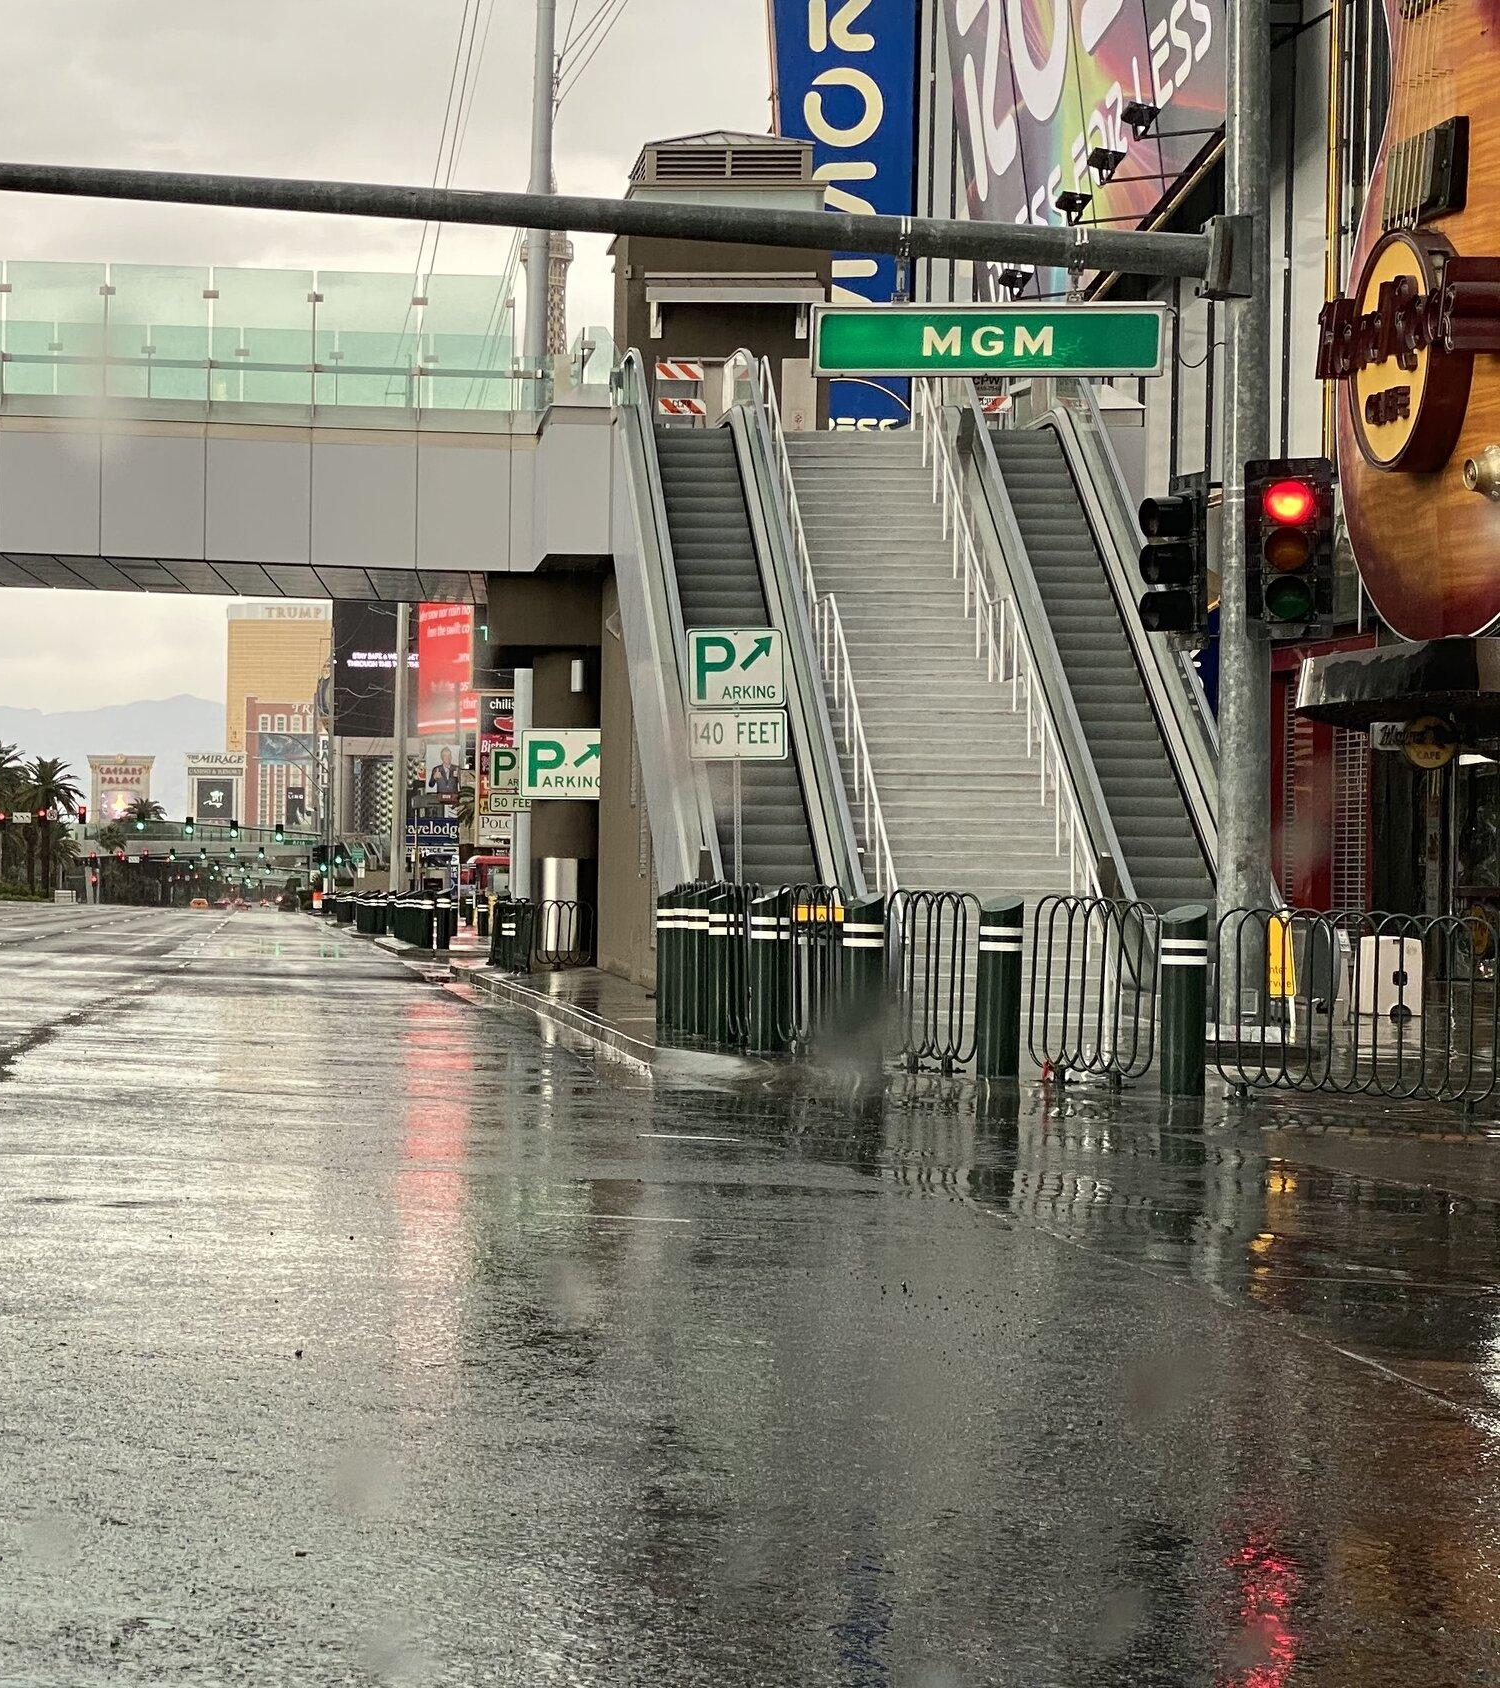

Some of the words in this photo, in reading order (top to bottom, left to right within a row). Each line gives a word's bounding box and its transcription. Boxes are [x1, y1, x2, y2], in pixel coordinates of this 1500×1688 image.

[922, 326, 1054, 356] MGM
[265, 606, 323, 618] TRUMP
[721, 685, 776, 700] ARKING
[694, 722, 724, 745] 140
[737, 721, 780, 744] FEET
[191, 754, 245, 765] MIRAGE
[99, 766, 143, 775] CAESARS
[101, 776, 141, 785] PALACE
[494, 797, 508, 808] 50
[406, 821, 460, 839] avelodg
